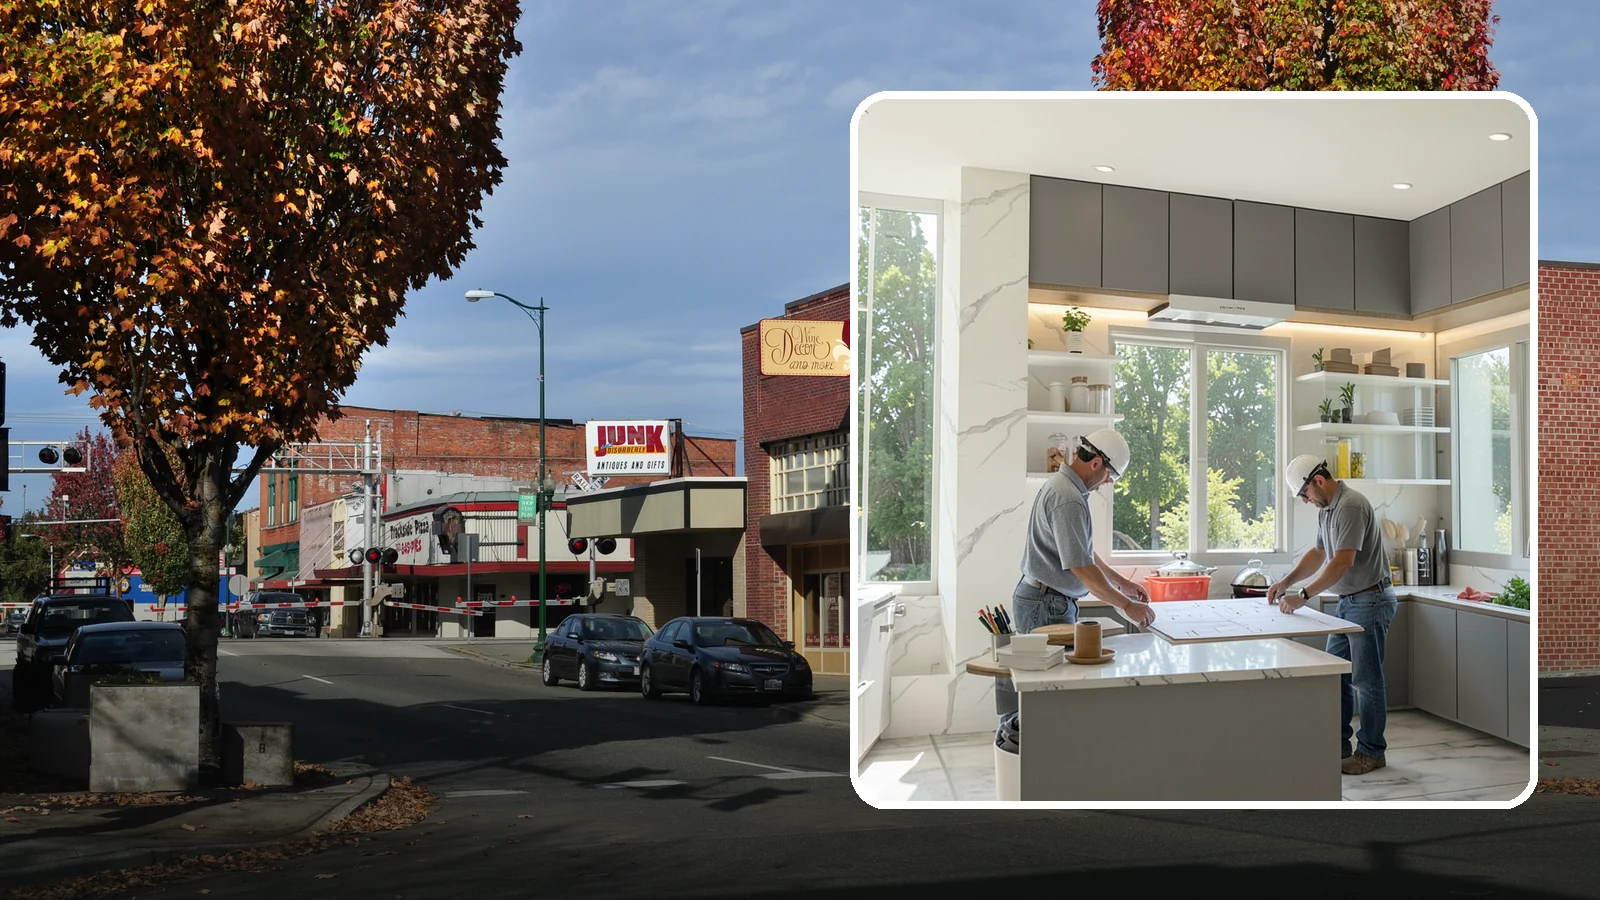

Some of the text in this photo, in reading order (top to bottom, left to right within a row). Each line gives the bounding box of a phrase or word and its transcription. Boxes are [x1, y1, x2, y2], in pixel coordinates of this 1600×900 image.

[595, 425, 665, 457] JUNK
[607, 446, 646, 454] DISORDERLY
[597, 461, 665, 470] ANTIQUES AND GIFTS
[414, 519, 429, 535] Pizza
